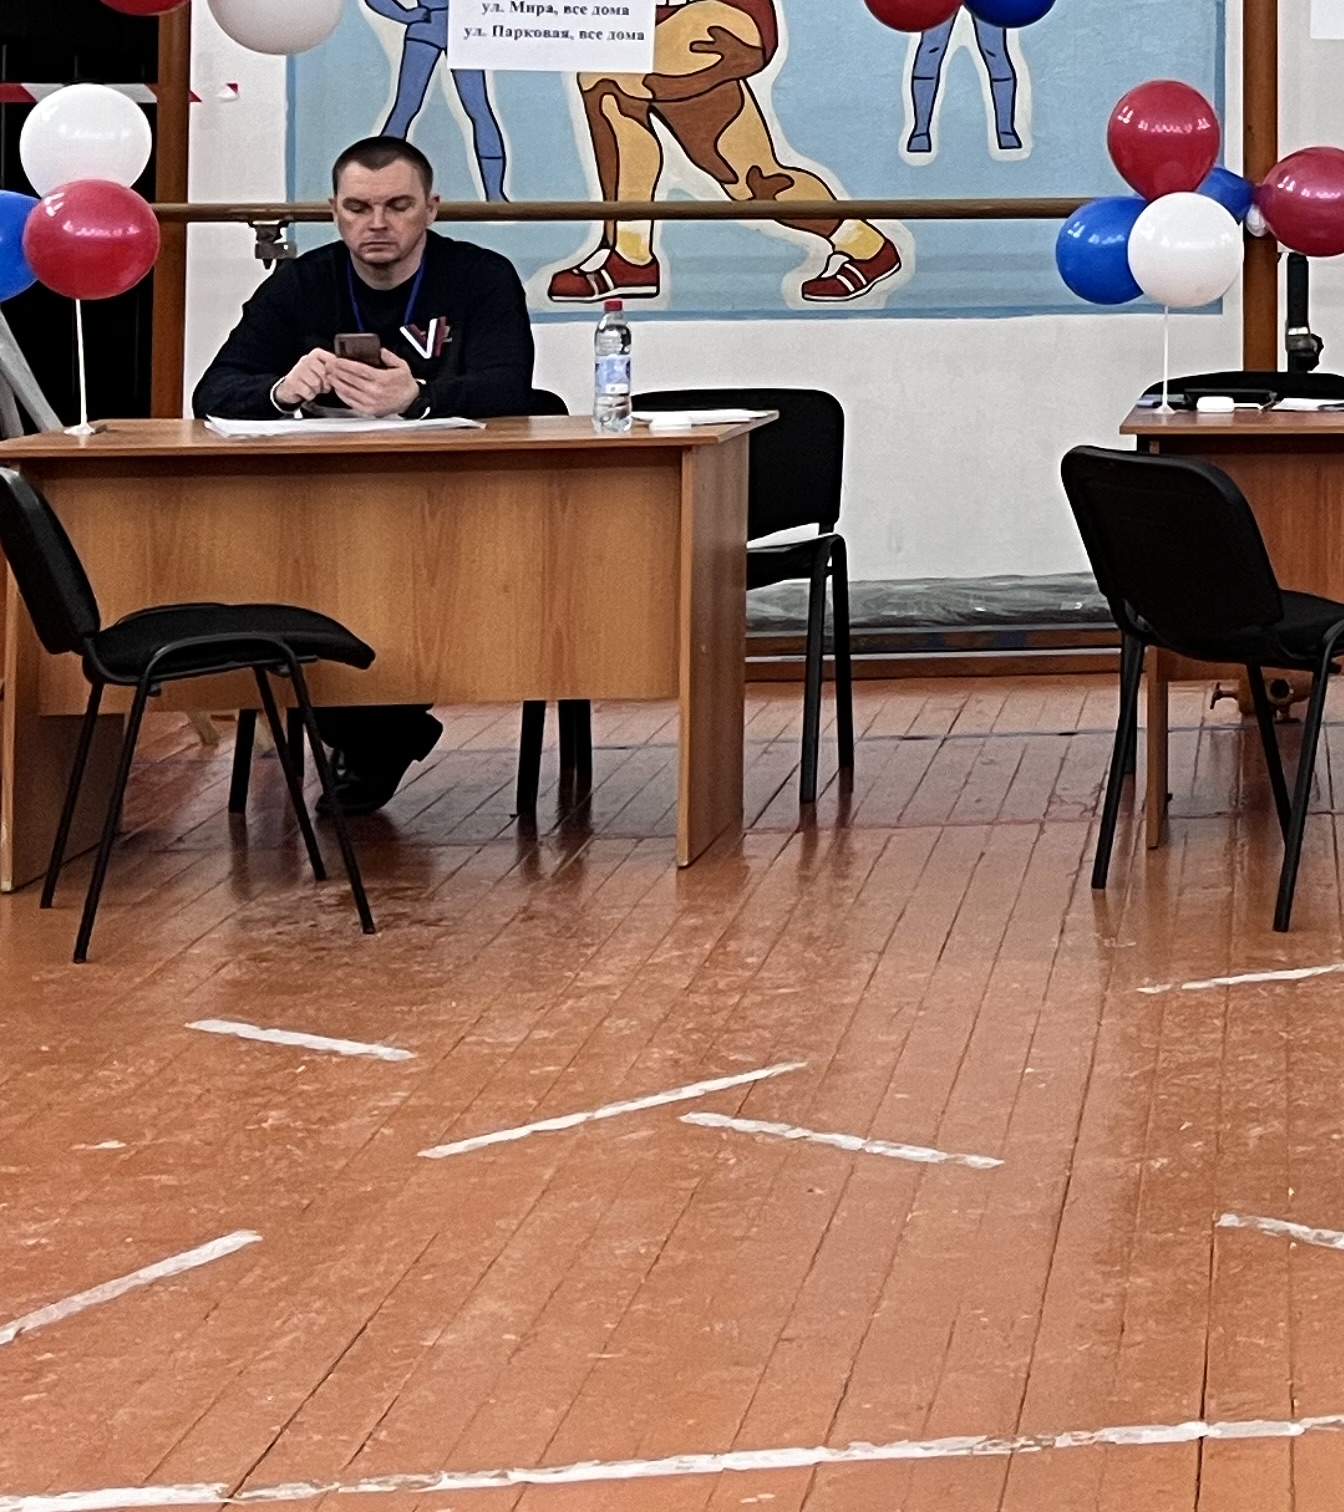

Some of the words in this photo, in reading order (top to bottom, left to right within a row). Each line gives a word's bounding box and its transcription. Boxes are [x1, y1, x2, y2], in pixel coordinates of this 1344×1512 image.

[481, 2, 504, 15] ул.
[509, 1, 558, 16] Мира,
[563, 5, 587, 15] все
[591, 5, 629, 16] дома
[464, 27, 486, 39] ул.
[492, 25, 574, 40] Парковая,
[579, 29, 603, 40] все
[607, 30, 645, 41] дома
